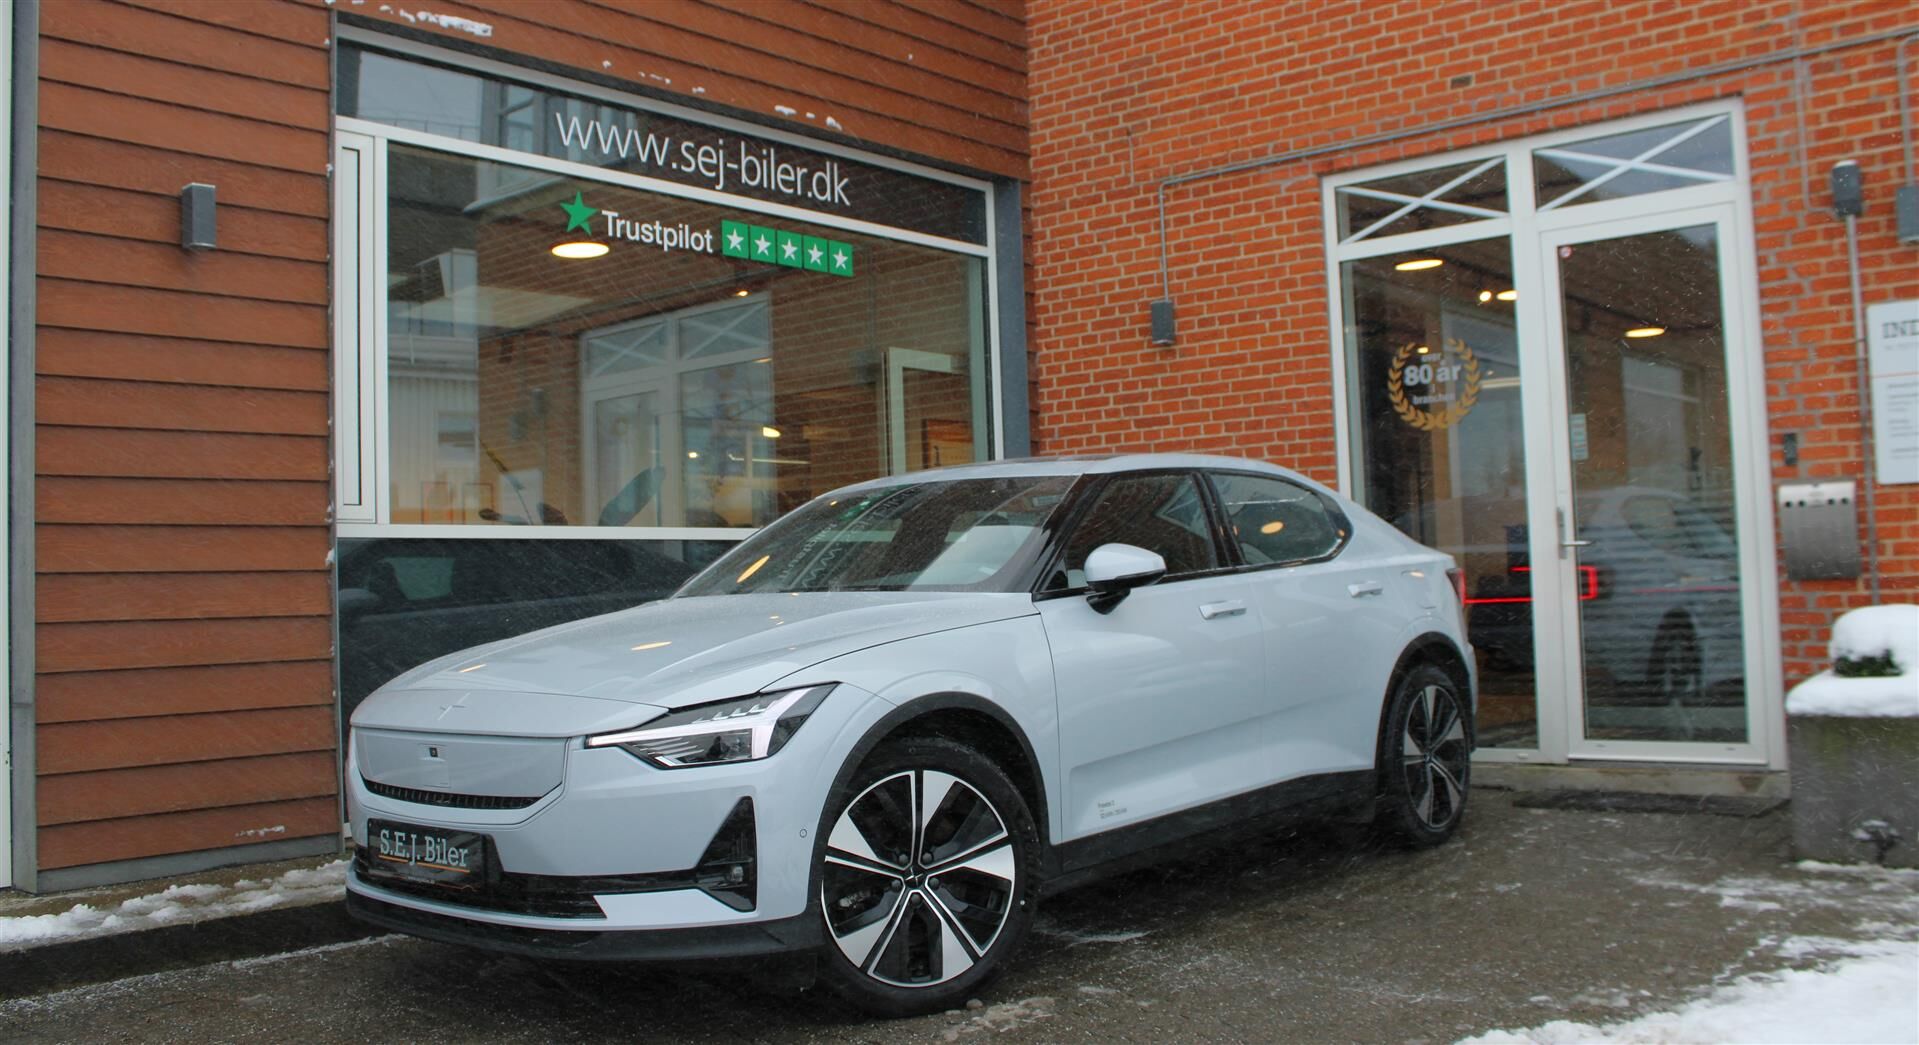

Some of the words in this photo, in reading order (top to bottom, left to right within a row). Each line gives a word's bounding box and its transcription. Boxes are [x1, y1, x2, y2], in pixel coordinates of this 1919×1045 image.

[555, 112, 851, 207] www.sej-biler.dk
[601, 209, 714, 254] Trustpilot
[1404, 364, 1433, 386] 80
[1436, 360, 1462, 382] år
[380, 829, 420, 866] S.E.J.
[424, 835, 469, 867] Biler
